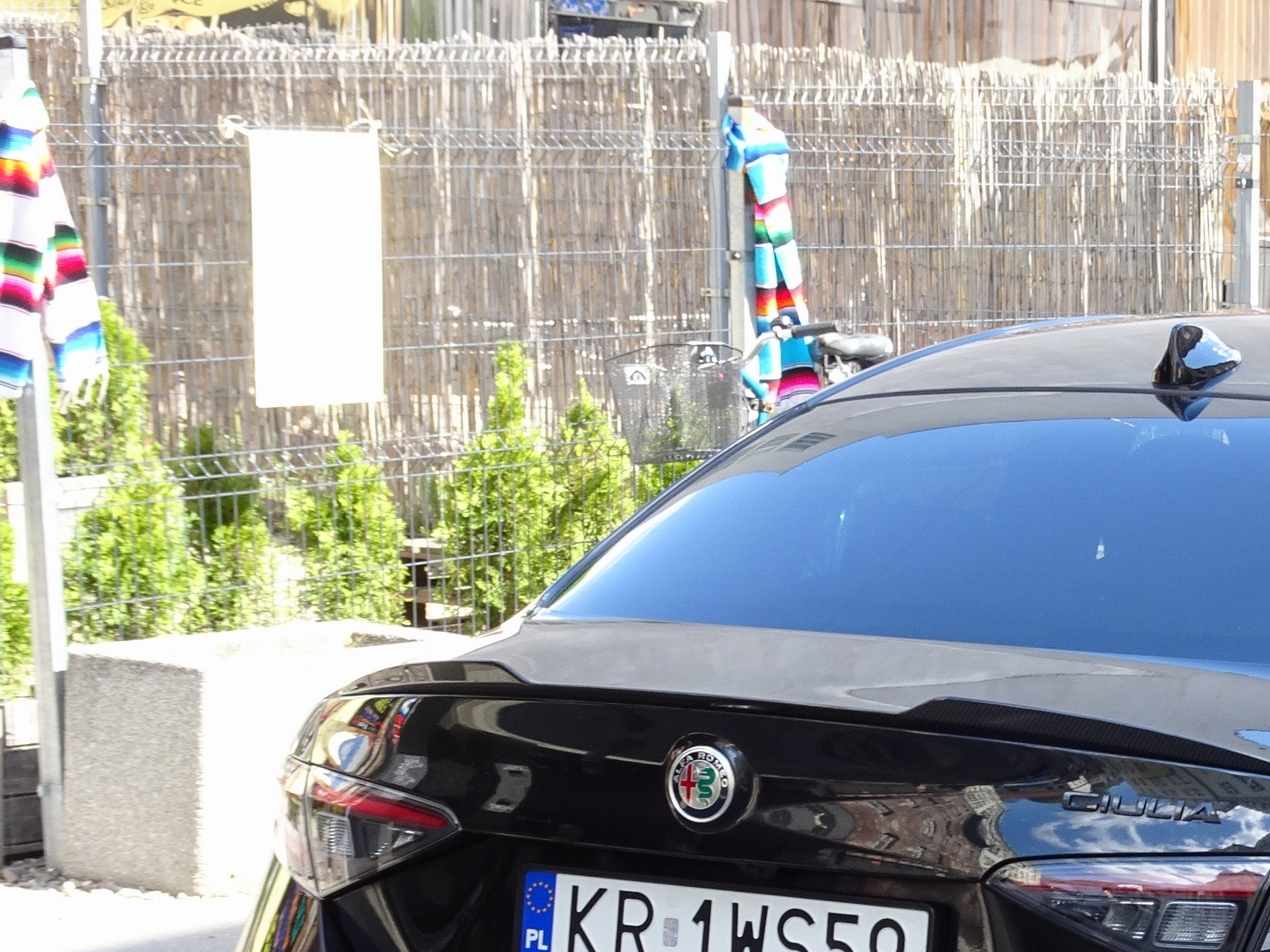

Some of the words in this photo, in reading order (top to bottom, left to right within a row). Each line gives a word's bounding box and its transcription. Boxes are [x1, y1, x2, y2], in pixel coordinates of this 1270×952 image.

[673, 754, 695, 783] ALFA
[697, 751, 729, 788] ROMEO
[1061, 791, 1222, 825] GIULIA
[524, 928, 550, 951] PL
